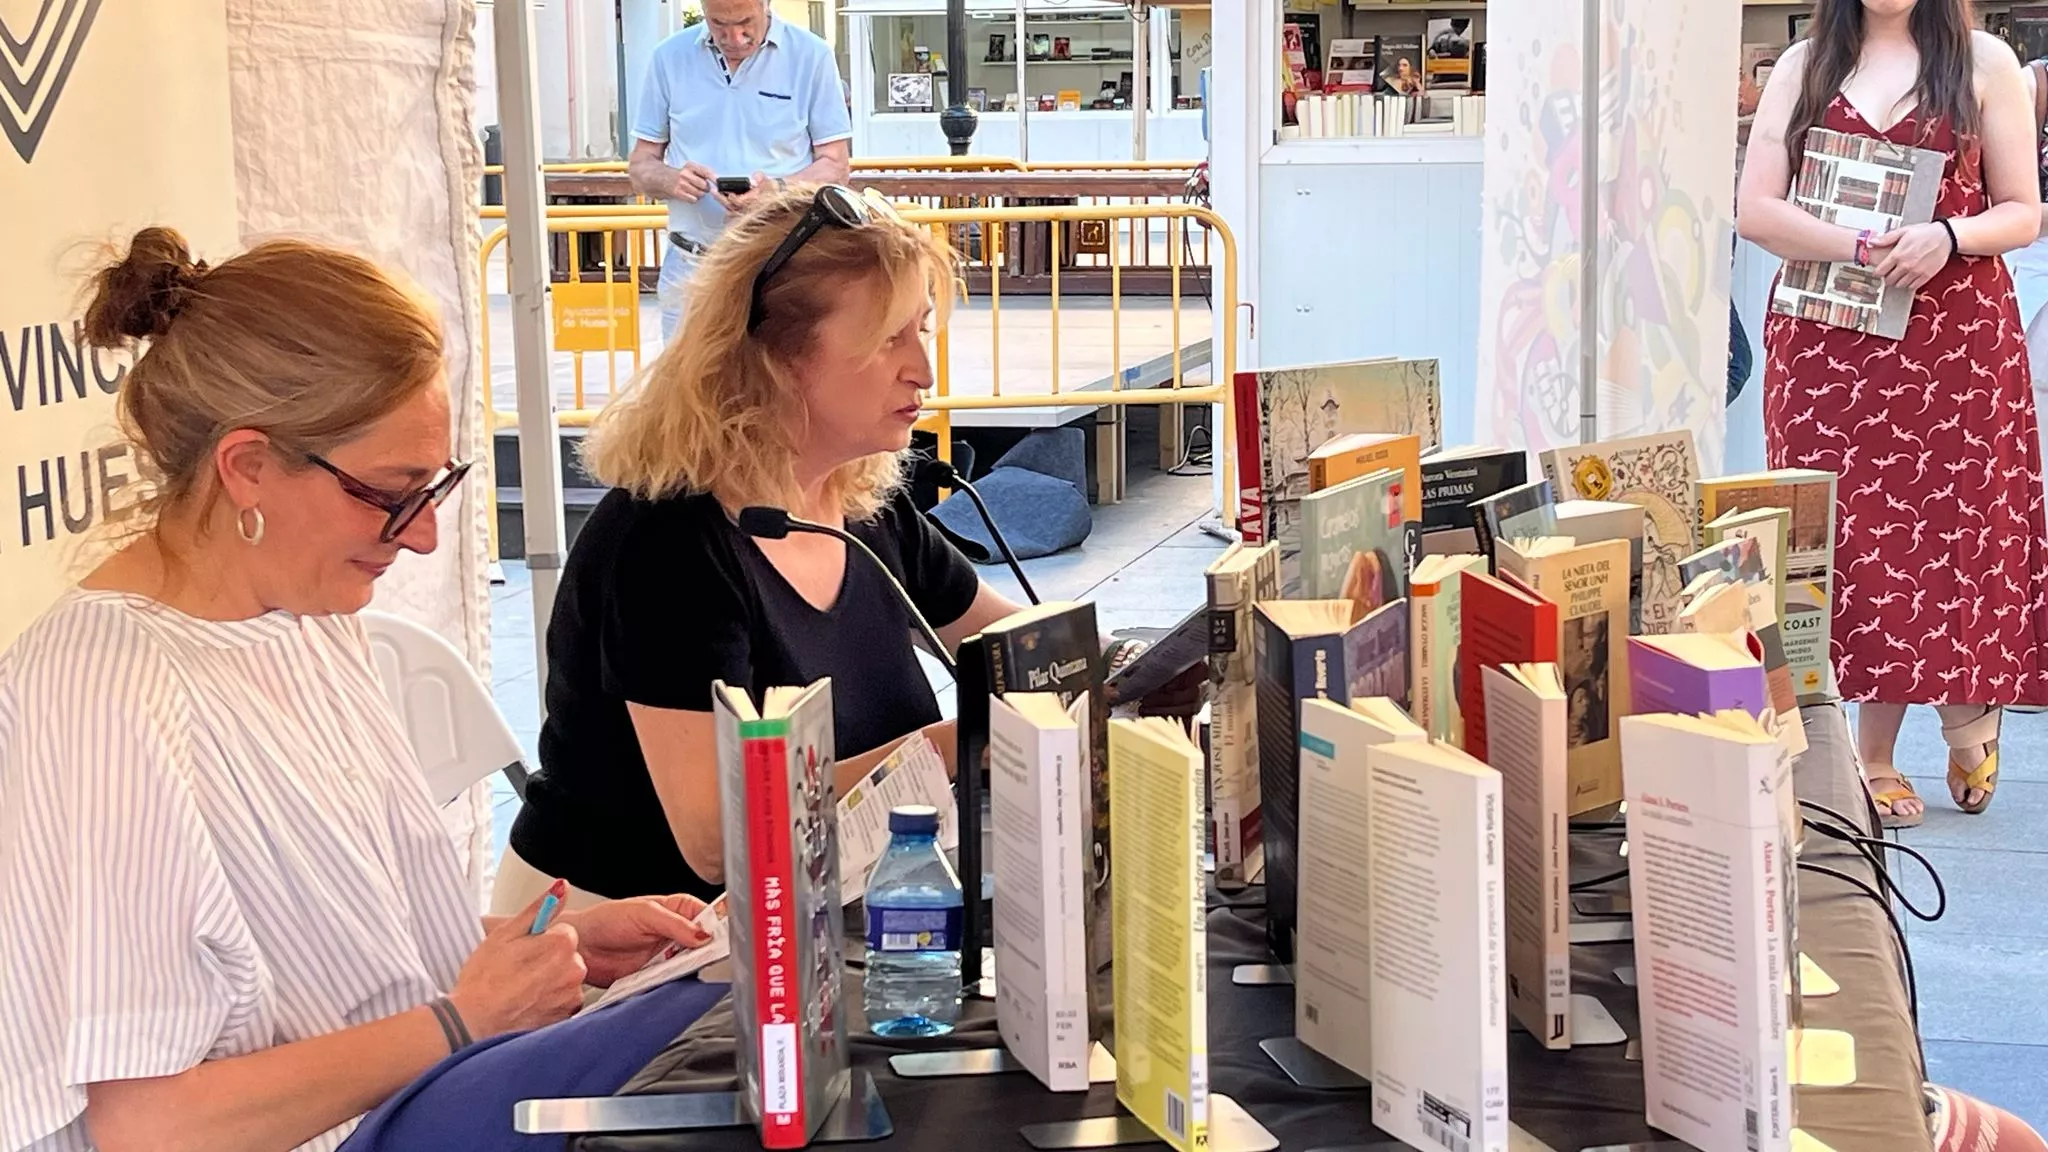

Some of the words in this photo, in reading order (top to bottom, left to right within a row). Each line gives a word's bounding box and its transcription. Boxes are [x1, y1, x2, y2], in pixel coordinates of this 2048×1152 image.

[0, 319, 128, 411] VINC
[18, 446, 136, 546] HUE
[1421, 488, 1437, 500] LAS
[1438, 483, 1475, 498] PRIMAS
[1241, 486, 1263, 547] LAVA
[1696, 499, 1705, 540] COAST
[1562, 569, 1572, 580] LA
[1573, 563, 1595, 576] NIETA
[1596, 559, 1610, 572] DEL
[1784, 617, 1821, 631] COAST
[1192, 769, 1205, 815] común
[1192, 818, 1205, 851] nada
[1764, 841, 1774, 874] Alana
[1193, 854, 1206, 902] lectora
[1193, 906, 1206, 932] Una
[1766, 889, 1777, 933] Portero
[1768, 937, 1779, 952] La
[768, 964, 785, 998] QUE
[1768, 954, 1780, 981] mala
[770, 1002, 786, 1024] LA
[1770, 982, 1781, 1040] costumbre
